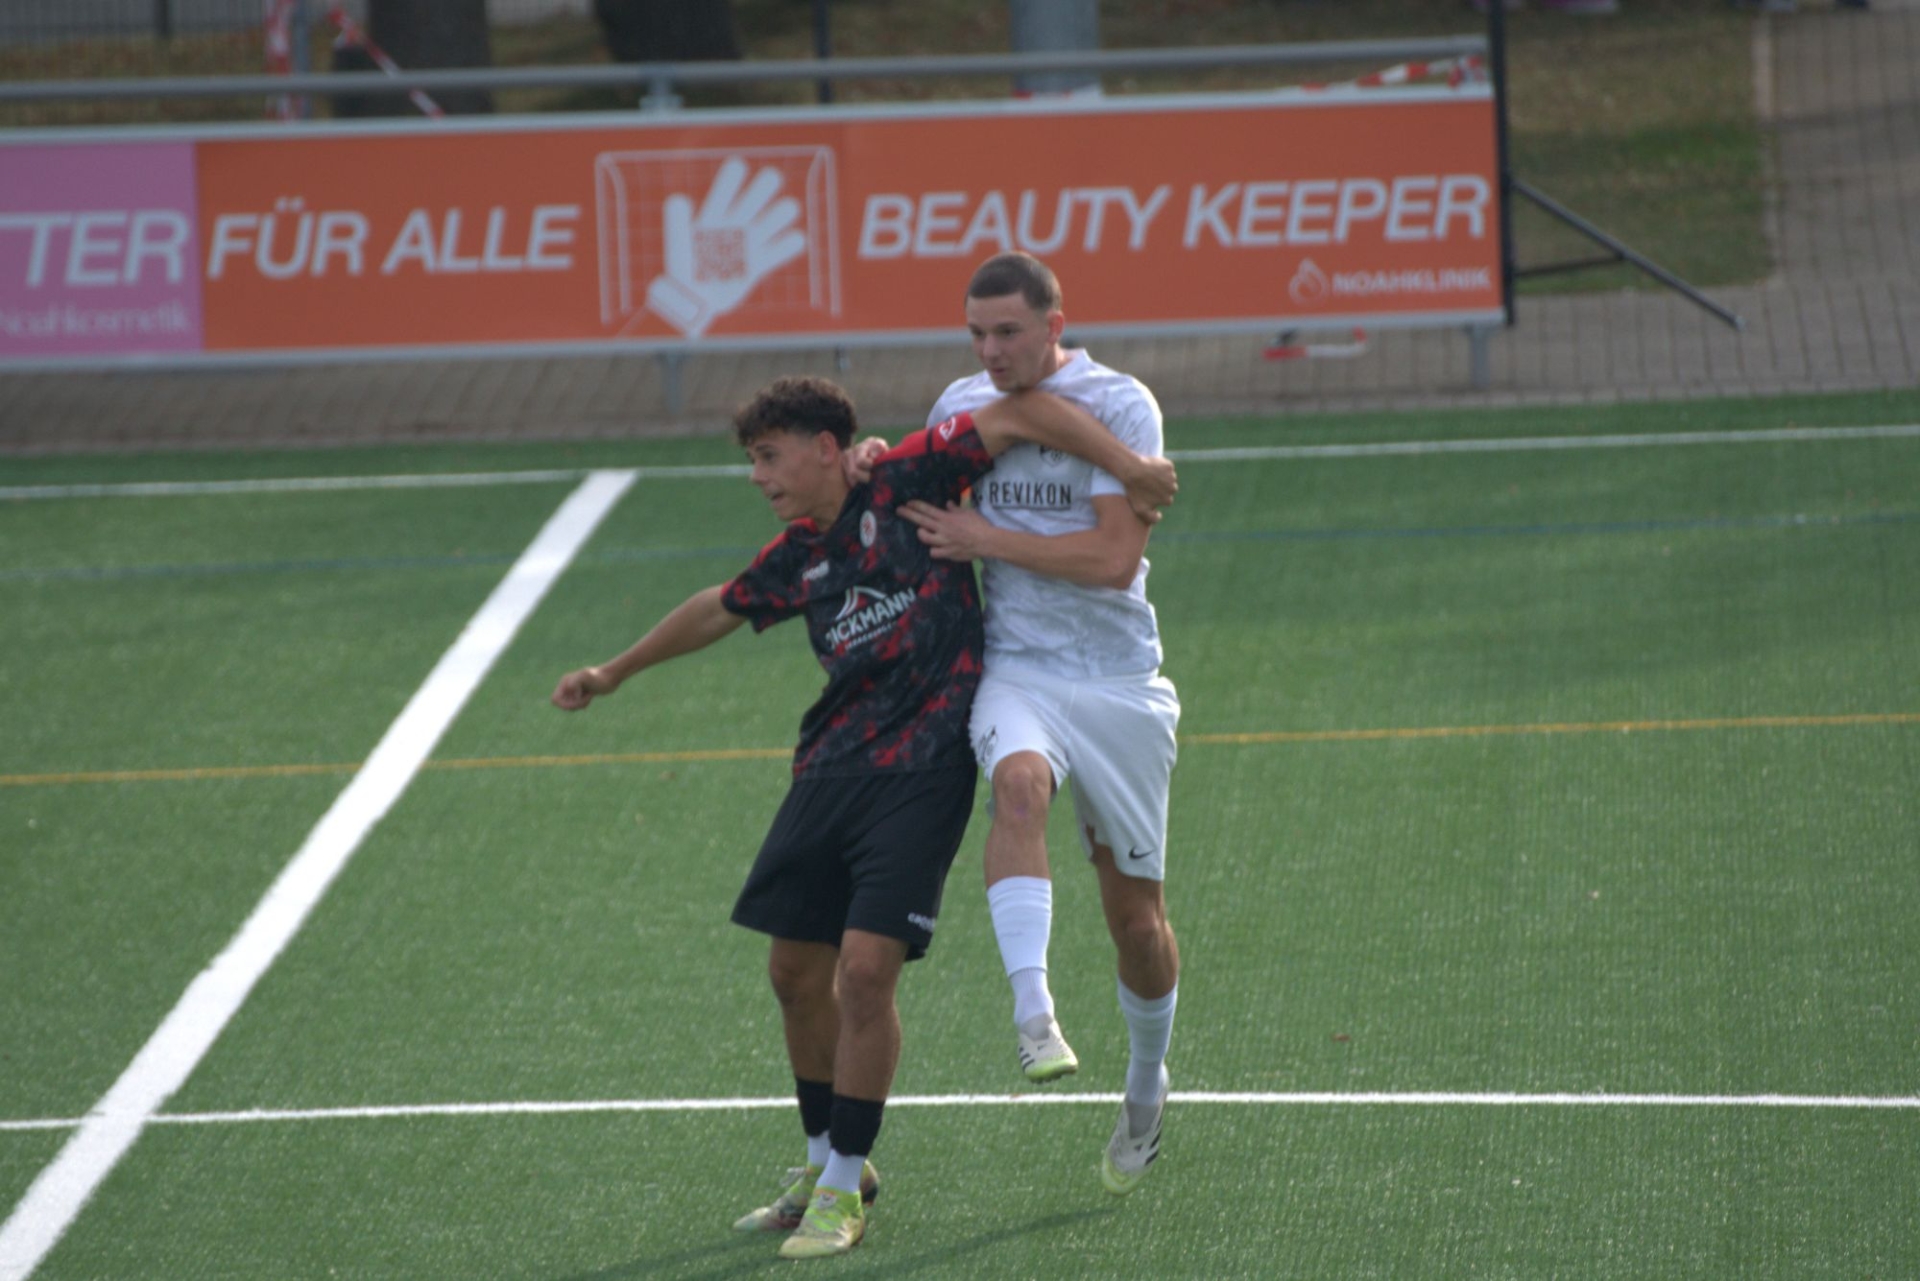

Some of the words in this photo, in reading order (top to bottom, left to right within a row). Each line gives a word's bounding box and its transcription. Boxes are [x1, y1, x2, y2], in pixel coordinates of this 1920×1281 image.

[207, 196, 369, 281] FÜR
[381, 204, 581, 274] ALLE
[857, 184, 1172, 259] BEAUTY
[1183, 174, 1491, 248] KEEPER
[1332, 266, 1491, 296] NOAHKLINIK
[989, 480, 1072, 506] REVIKON
